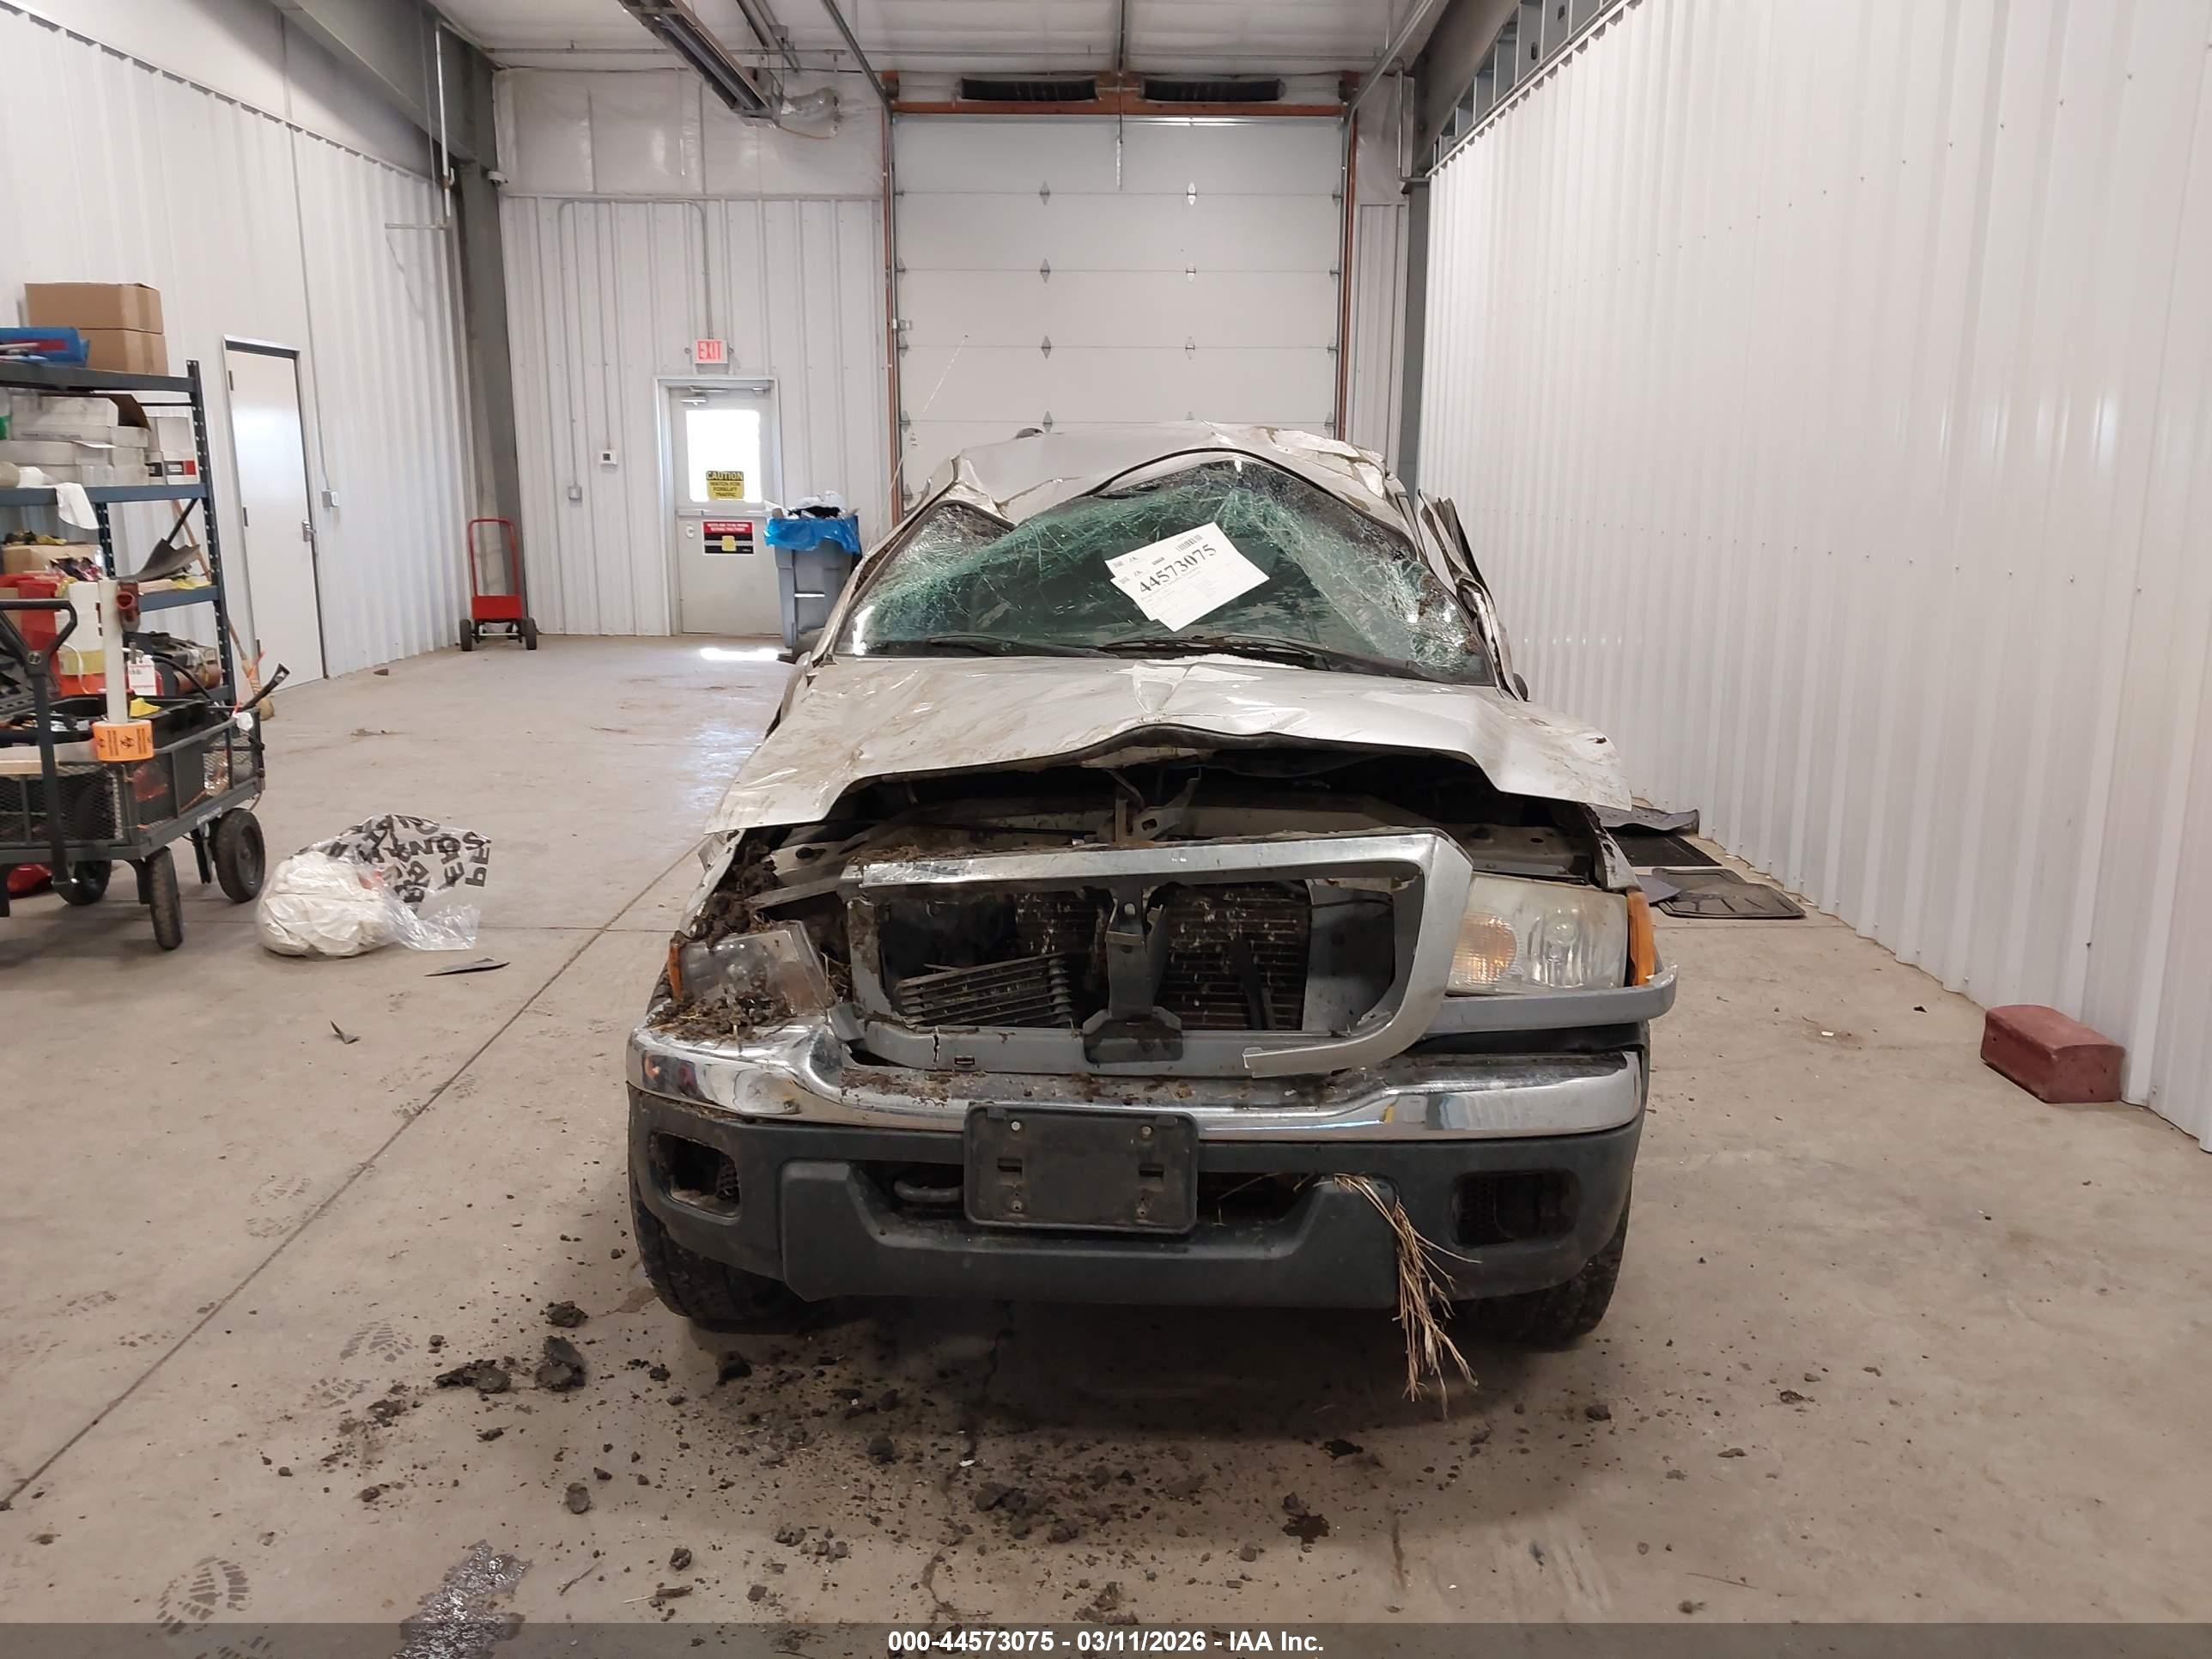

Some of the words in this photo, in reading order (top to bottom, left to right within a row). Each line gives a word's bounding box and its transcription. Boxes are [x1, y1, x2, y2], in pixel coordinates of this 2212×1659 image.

[696, 340, 722, 360] EXIT
[707, 471, 744, 481] CAUTION
[1139, 544, 1217, 593] 44573075
